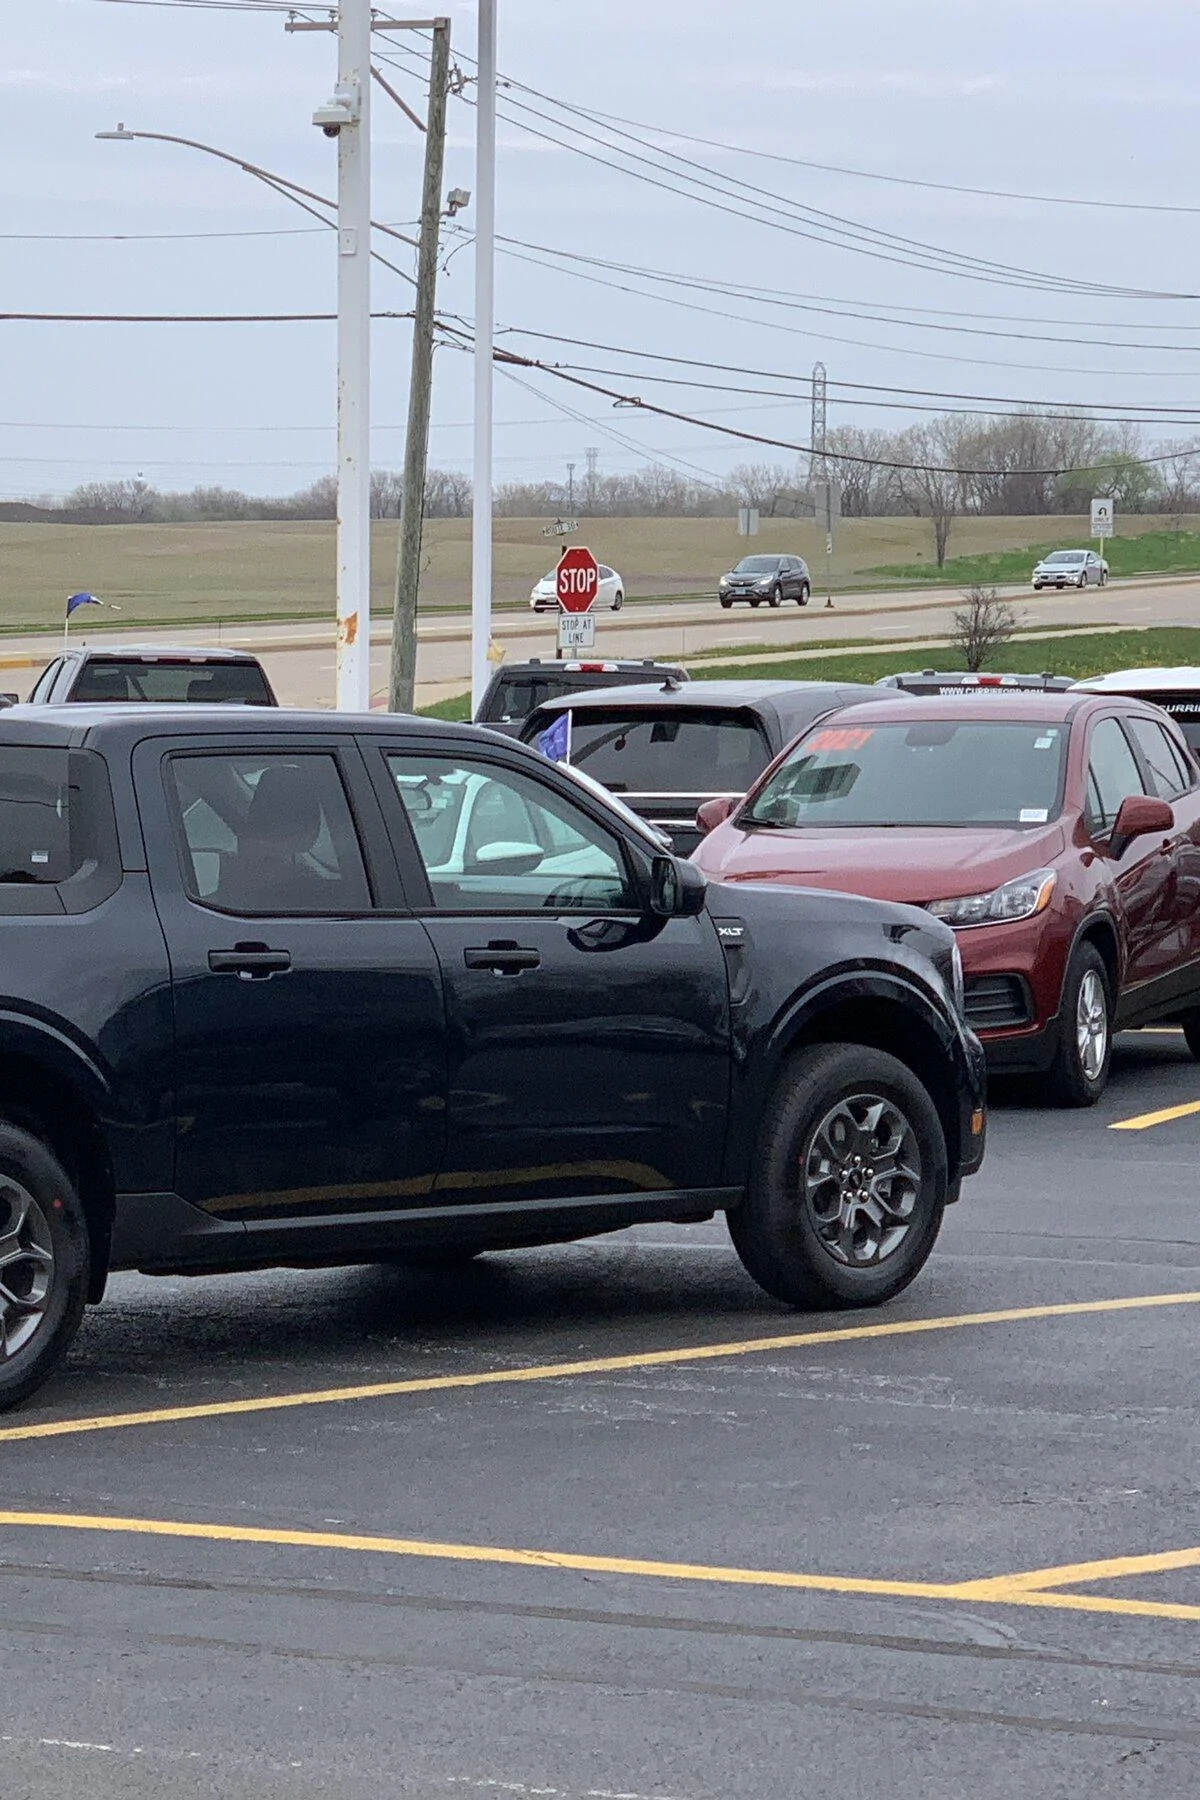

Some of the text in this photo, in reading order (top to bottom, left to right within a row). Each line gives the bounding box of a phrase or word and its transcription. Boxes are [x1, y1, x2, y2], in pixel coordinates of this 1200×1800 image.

[560, 568, 596, 593] STOP
[561, 619, 592, 631] STOP AT
[568, 633, 584, 643] LINE
[718, 927, 744, 936] XLT
